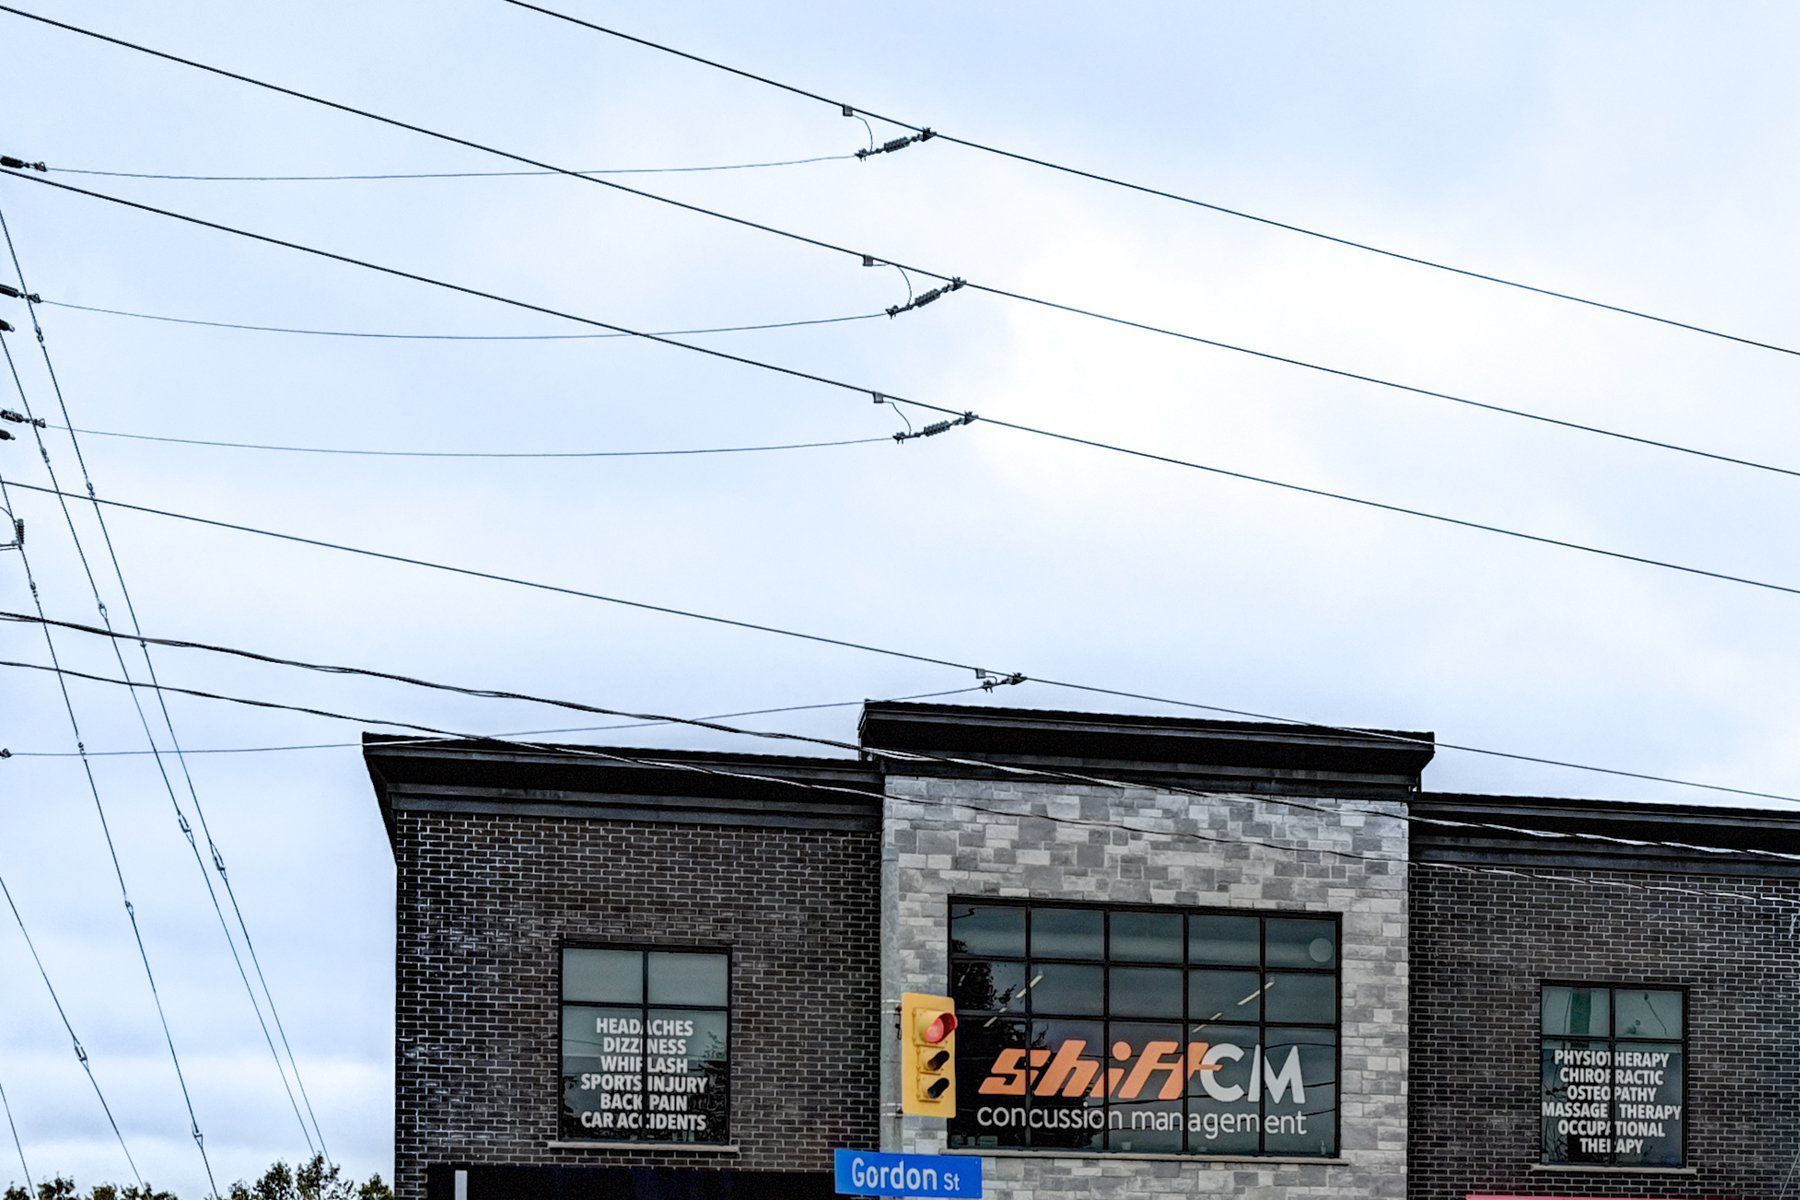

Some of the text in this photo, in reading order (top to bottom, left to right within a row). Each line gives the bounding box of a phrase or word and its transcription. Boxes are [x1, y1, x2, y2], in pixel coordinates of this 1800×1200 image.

[596, 1017, 693, 1036] HEADACHES
[603, 1037, 687, 1055] DIZZINESS
[601, 1056, 688, 1074] WHIPLASH
[1554, 1050, 1669, 1067] PHYSIOTHERAPY
[581, 1074, 708, 1093] SPORTS INJURY
[1560, 1067, 1664, 1085] CHIROPRACTIC
[600, 1093, 688, 1112] BACK PAIN
[1567, 1085, 1657, 1102] OSTEOPATHY
[977, 1100, 1306, 1140] concussion management
[1542, 1102, 1681, 1120] MASSAGE THERAPY
[581, 1111, 707, 1131] CAR ACCIDENTS
[852, 1157, 960, 1191] Gordon St
